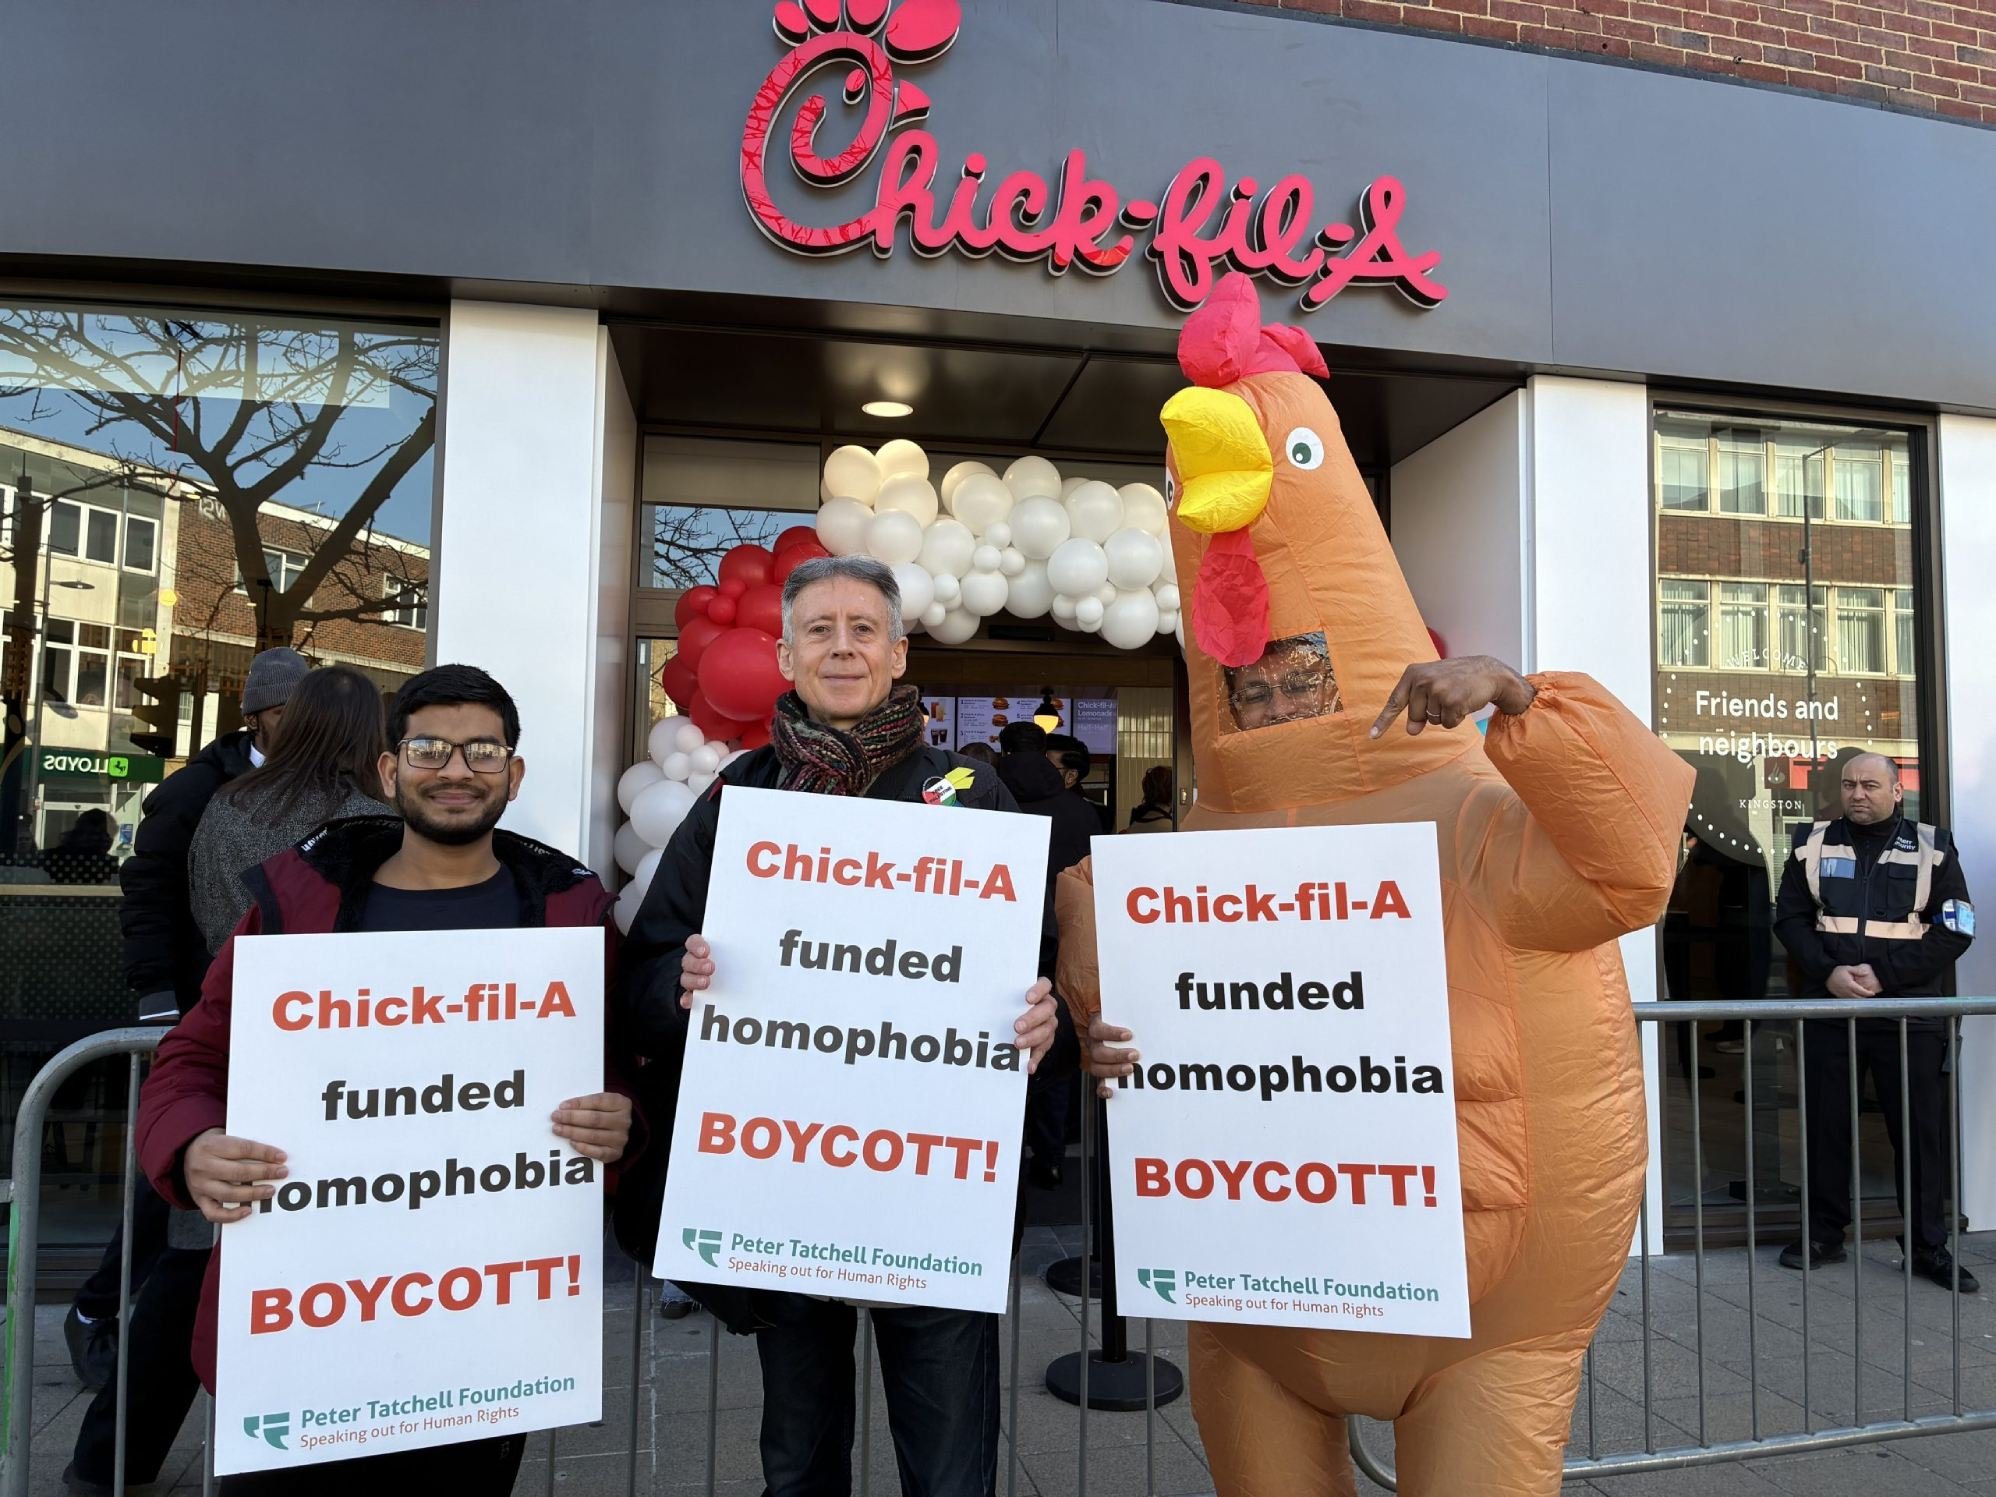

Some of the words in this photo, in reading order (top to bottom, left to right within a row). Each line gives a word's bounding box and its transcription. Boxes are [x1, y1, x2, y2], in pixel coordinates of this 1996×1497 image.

[742, 20, 1448, 306] Chick-fil-A
[1727, 648, 1809, 671] WELCOME
[1696, 690, 1788, 718] Friends
[1795, 696, 1839, 720] and
[1700, 730, 1838, 763] neighbours
[1740, 800, 1802, 809] KINGSTON
[746, 841, 1017, 902] Chick-fil-A
[1126, 880, 1412, 924] Chick-fil-A
[779, 929, 963, 983] funded
[272, 981, 577, 1031] Chick-fil-A
[1175, 971, 1365, 1010] funded
[700, 1004, 1021, 1072] homophobia
[321, 1069, 525, 1121] funded
[698, 1111, 999, 1183] BOYCOTT!
[1134, 1157, 1438, 1207] BOYCOTT!
[728, 1257, 787, 1277] Speaking
[790, 1266, 812, 1277] out
[816, 1265, 834, 1279] for
[837, 1268, 883, 1284] Human
[887, 1273, 927, 1290] Rights
[731, 1233, 785, 1256] Peter
[789, 1239, 867, 1265] Tatchell
[871, 1248, 983, 1276] Foundation
[250, 1254, 581, 1335] BOYCOTT!
[1184, 1271, 1235, 1290] Peter
[1240, 1274, 1319, 1295] Tatchell
[1323, 1278, 1440, 1302] Foundation
[1185, 1293, 1242, 1311] Speaking
[1246, 1299, 1267, 1309] out
[1270, 1298, 1288, 1310] for
[1293, 1300, 1338, 1314] Human
[1342, 1302, 1384, 1318] Rights
[301, 1407, 361, 1428] Peter
[367, 1390, 454, 1419] Tatchell
[459, 1376, 575, 1406] Foundation
[300, 1428, 367, 1450] Speaking
[371, 1424, 395, 1437] out
[399, 1420, 419, 1433] for
[424, 1413, 472, 1430] Human
[477, 1407, 519, 1423] Rights
